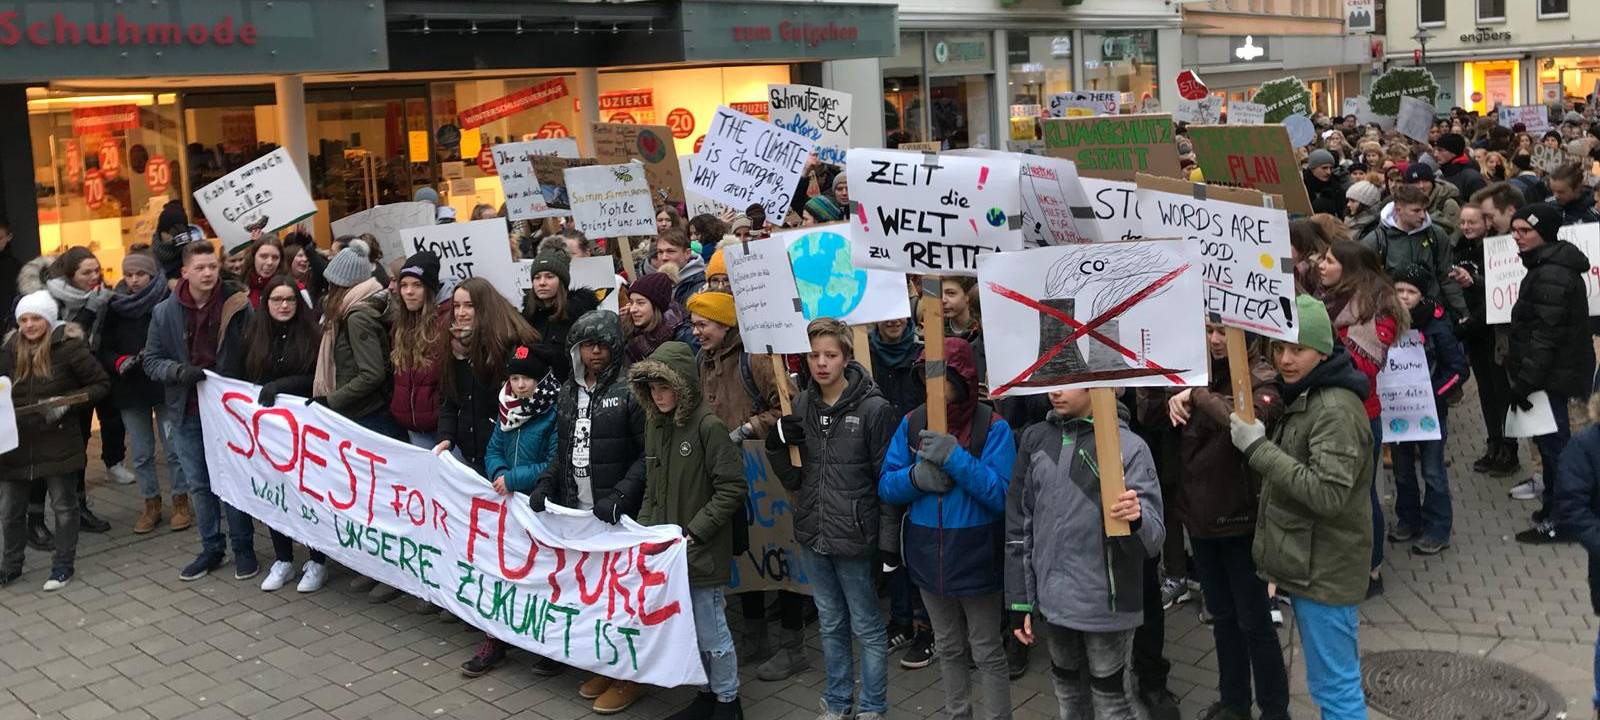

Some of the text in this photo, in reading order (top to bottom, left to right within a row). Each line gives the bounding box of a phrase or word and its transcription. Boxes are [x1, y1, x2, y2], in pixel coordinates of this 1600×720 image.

[0, 11, 257, 46] Schuhmode
[733, 19, 858, 47] zum Gutgehen
[1460, 31, 1511, 42] engbers
[1181, 79, 1202, 91] STO
[1375, 90, 1400, 100] PLANT
[1408, 85, 1429, 95] TREE
[599, 93, 648, 108] UZIERT
[770, 87, 840, 113] Schmutziger
[1284, 92, 1303, 104] TREE
[669, 115, 691, 131] 20
[718, 111, 753, 145] THE
[817, 110, 849, 136] SEX
[1044, 119, 1171, 148] KLIMASCHUTZ
[706, 142, 722, 163] is
[1076, 147, 1148, 170] STATT
[148, 163, 168, 187] 50
[694, 165, 721, 190] WHY
[866, 160, 944, 187] ZEIT
[1227, 154, 1280, 185] PLAN
[234, 183, 254, 197] zum
[940, 189, 971, 208] die
[599, 202, 637, 217] Kohle
[1094, 188, 1142, 220] ST
[581, 218, 613, 232] bringt
[636, 217, 653, 226] um
[876, 206, 959, 237] WELT
[1158, 199, 1273, 246] WORDS ARE
[413, 236, 473, 260] KOHLE
[869, 246, 890, 260] zu
[450, 262, 474, 279] IST
[1245, 270, 1283, 296] ARE
[1204, 286, 1294, 329] ETTER!
[602, 397, 619, 408] NYC
[221, 391, 682, 627] SOEST FOR FUTURE
[250, 476, 641, 672] Weil es UNSERE ZUKUNFT IST
